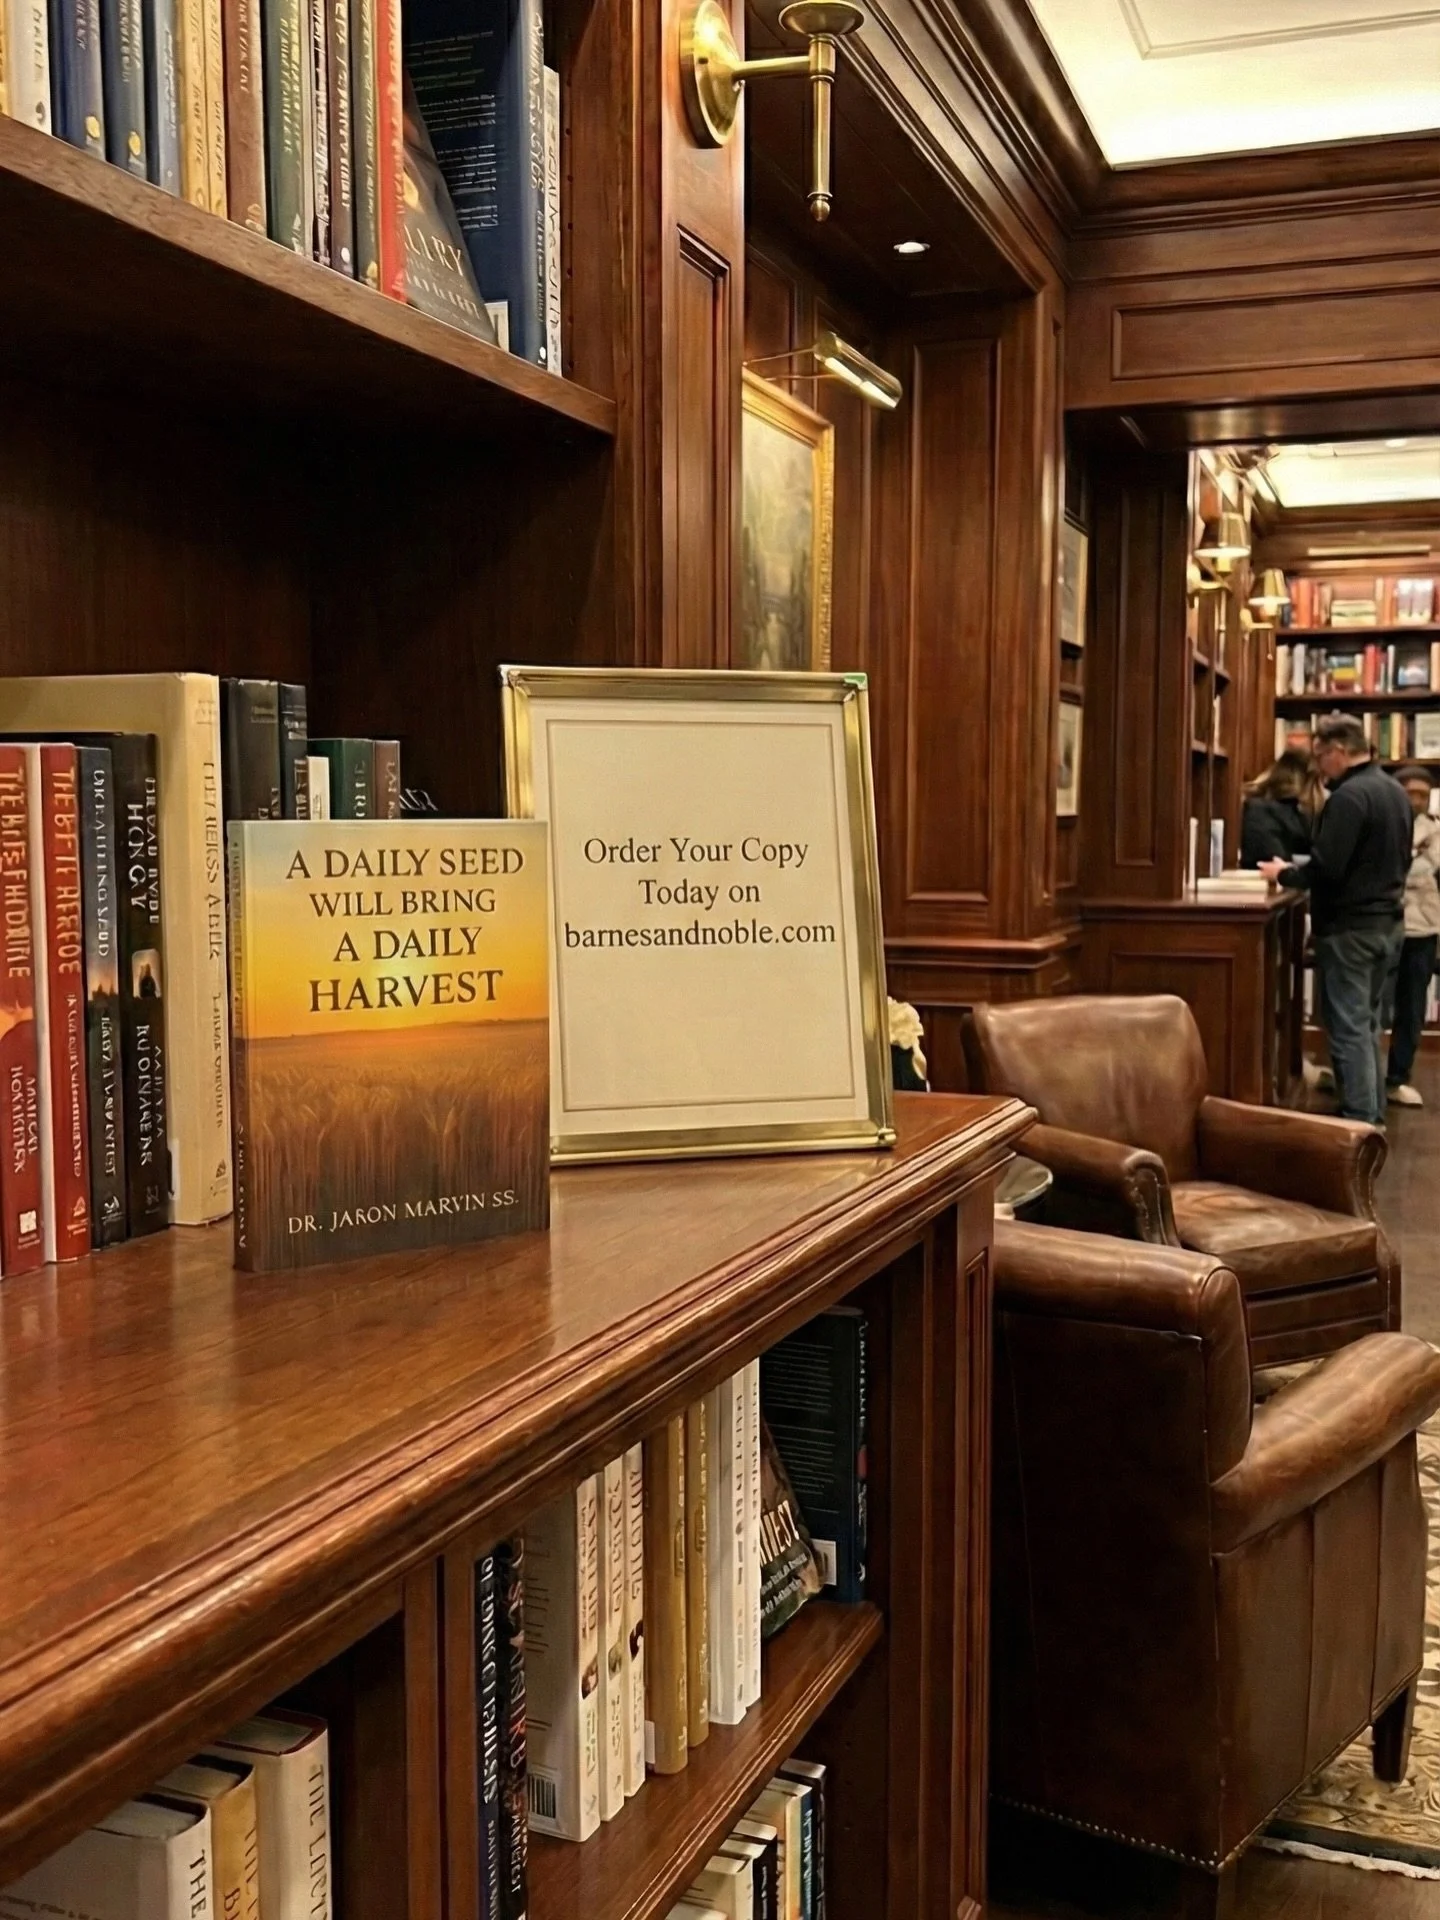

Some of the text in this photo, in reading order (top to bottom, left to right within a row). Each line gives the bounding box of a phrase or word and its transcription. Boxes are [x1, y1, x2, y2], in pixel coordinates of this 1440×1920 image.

[285, 848, 524, 880] A DAILY SEED
[584, 837, 809, 869] Order Your Copy
[309, 888, 496, 918] WILL BRING
[638, 878, 761, 911] Today on
[333, 927, 483, 962] A DAILY
[565, 918, 836, 949] barnesandnoble.com
[309, 969, 504, 1013] HARVEST
[288, 1215, 323, 1234] DR.
[404, 1192, 486, 1219] MARVIN
[189, 1849, 207, 1919] THE
